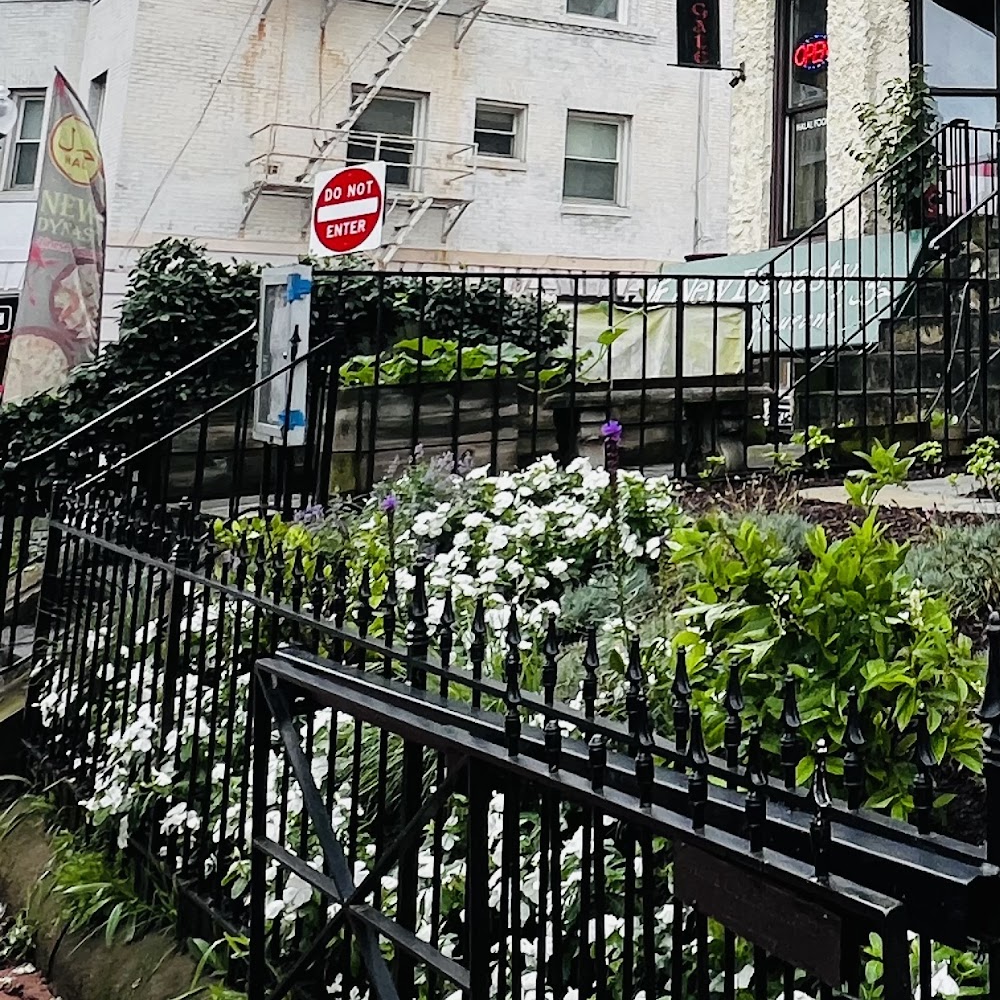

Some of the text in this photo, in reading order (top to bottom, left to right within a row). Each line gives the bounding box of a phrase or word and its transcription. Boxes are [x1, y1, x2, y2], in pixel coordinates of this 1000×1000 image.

[324, 180, 374, 202] DO NOT
[326, 219, 366, 239] ENTER
